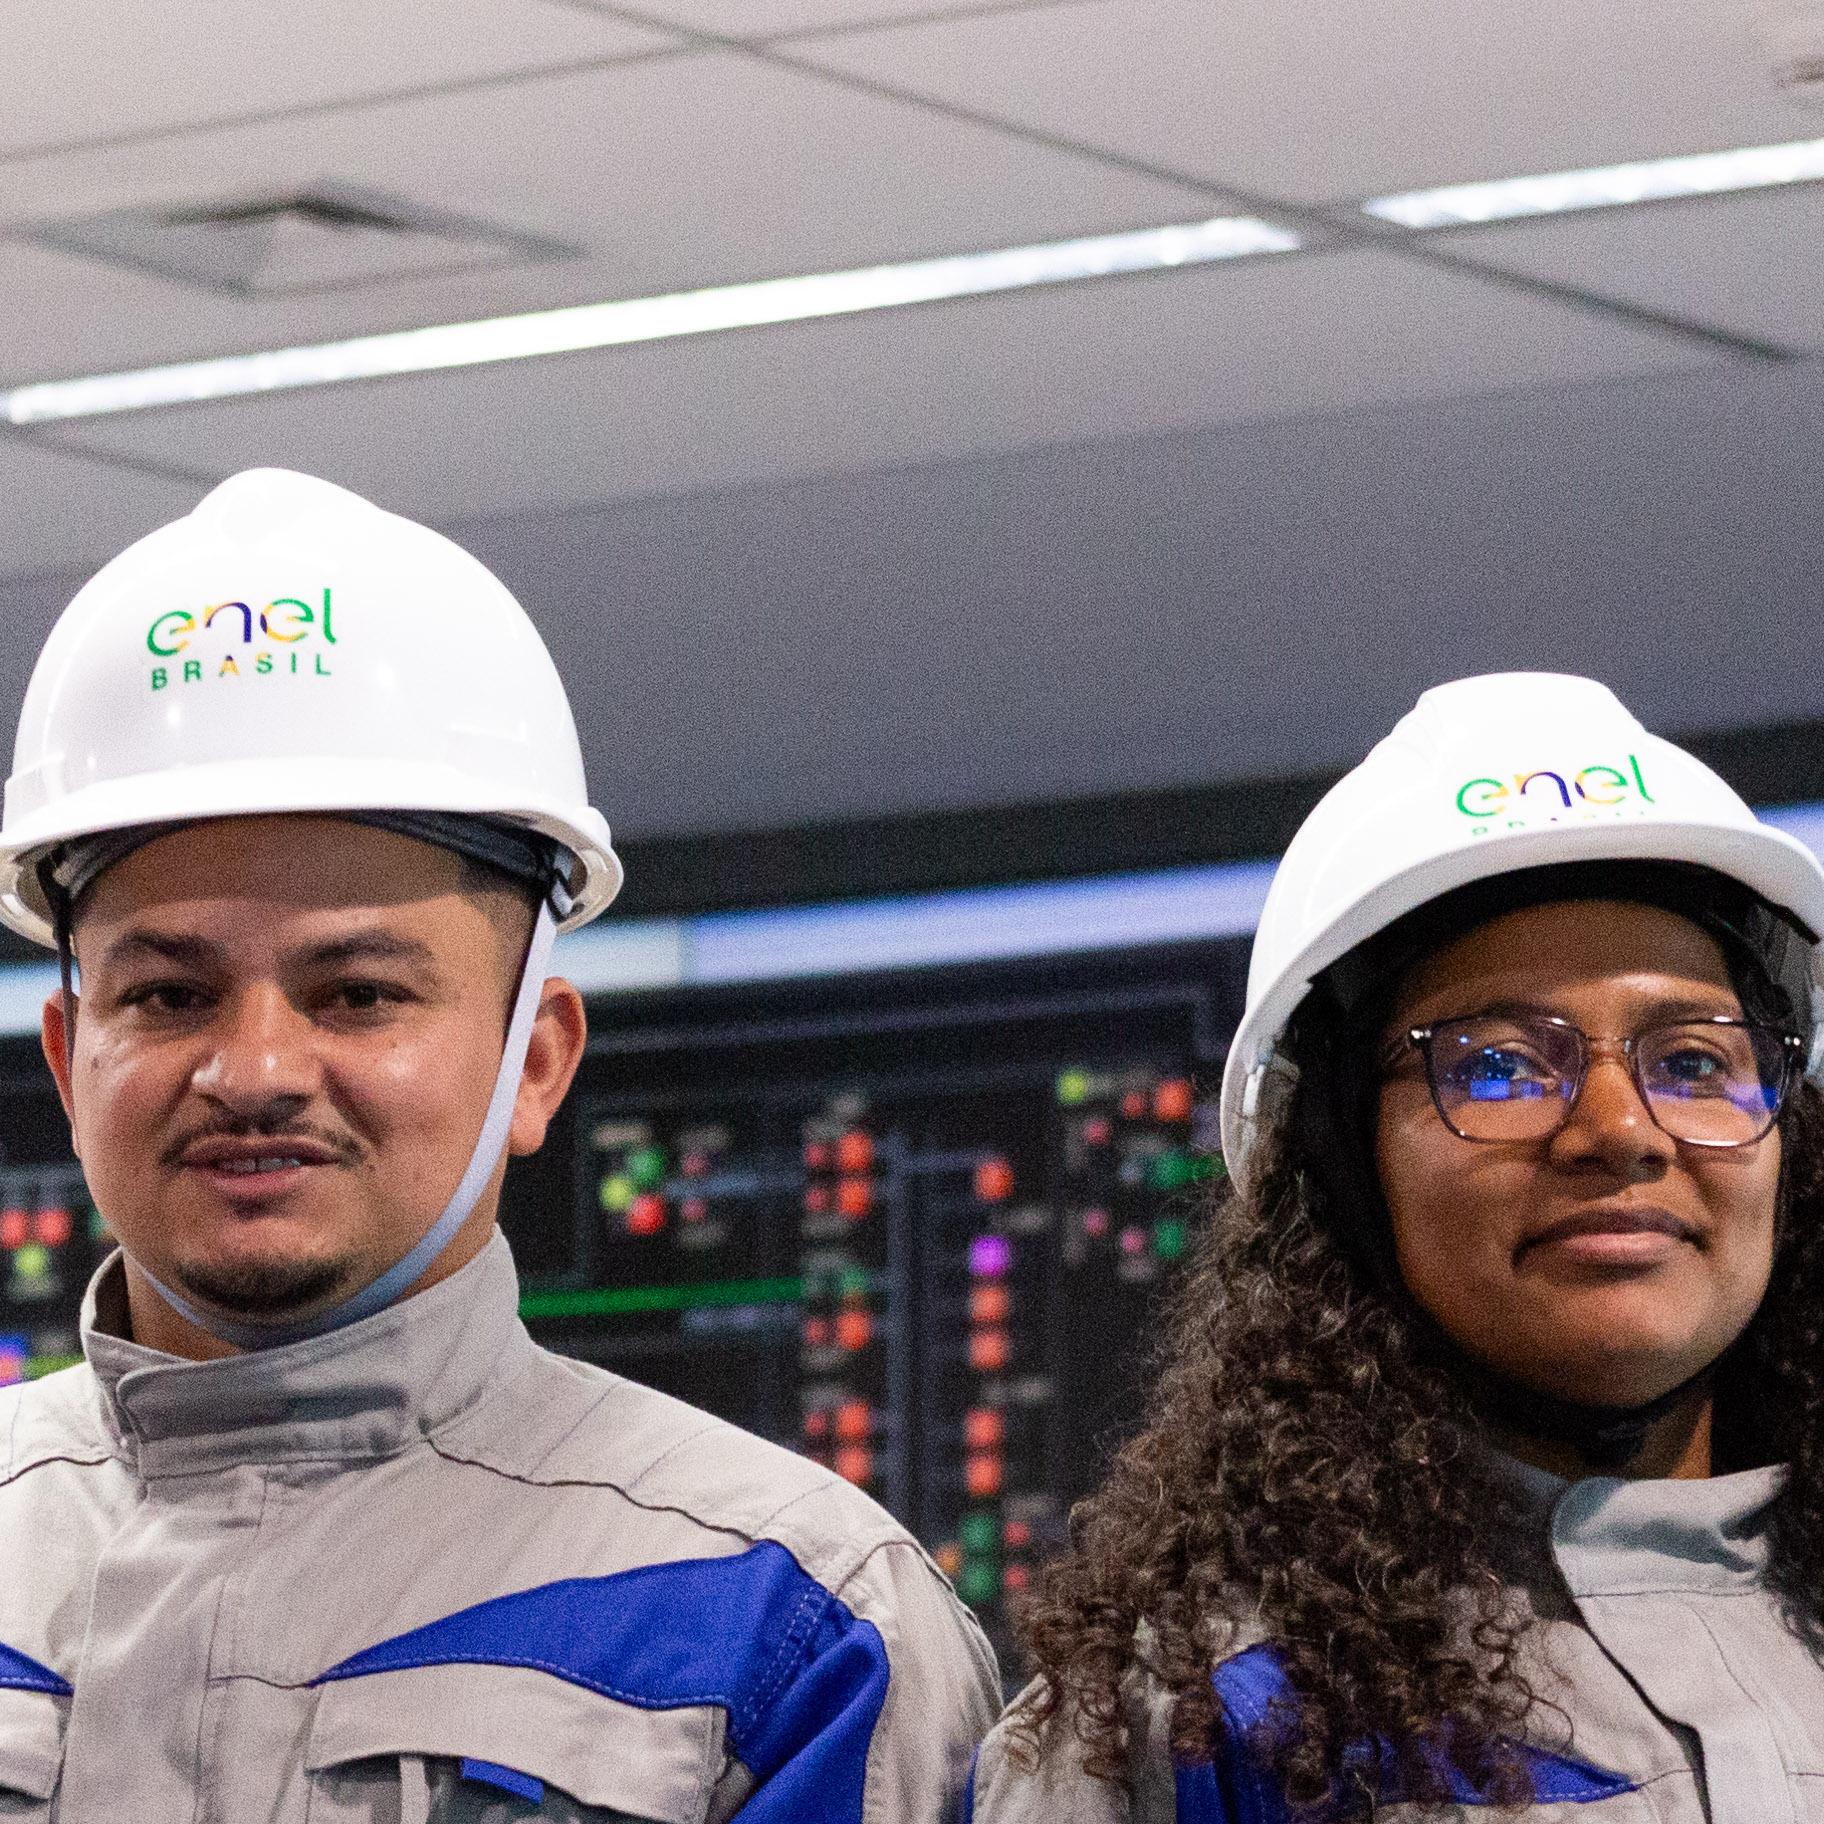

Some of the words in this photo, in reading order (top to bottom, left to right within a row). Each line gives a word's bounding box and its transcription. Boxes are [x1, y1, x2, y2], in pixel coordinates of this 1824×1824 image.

[146, 587, 338, 658] enel
[150, 652, 332, 692] BRASIL
[1455, 753, 1656, 818] enel
